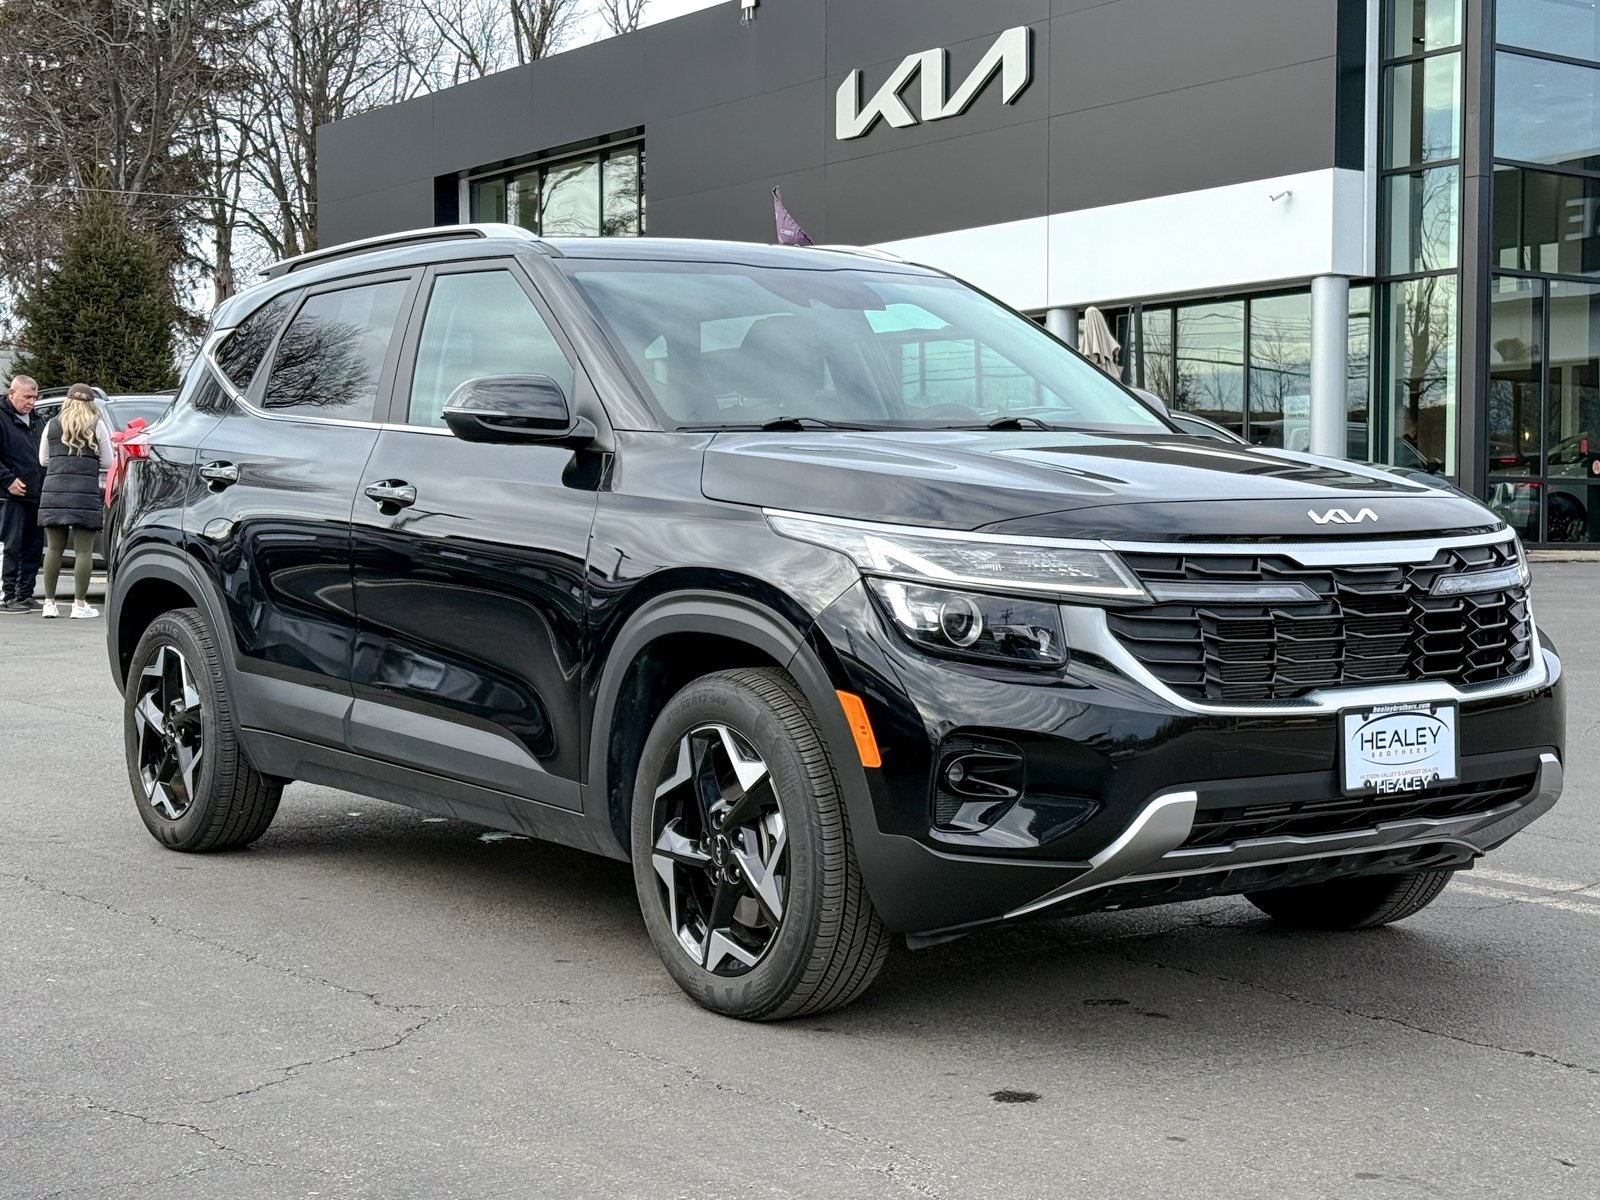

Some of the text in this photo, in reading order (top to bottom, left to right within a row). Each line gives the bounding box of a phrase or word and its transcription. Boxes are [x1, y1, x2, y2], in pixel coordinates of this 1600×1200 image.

[836, 26, 1030, 140] KIA
[1307, 508, 1379, 525] KIA
[147, 624, 179, 639] SOLUS
[1372, 703, 1431, 713] healeybrothers.com
[1360, 725, 1442, 751] HEALEY
[1371, 747, 1427, 758] BROTHERS
[1375, 775, 1429, 795] HEALEY
